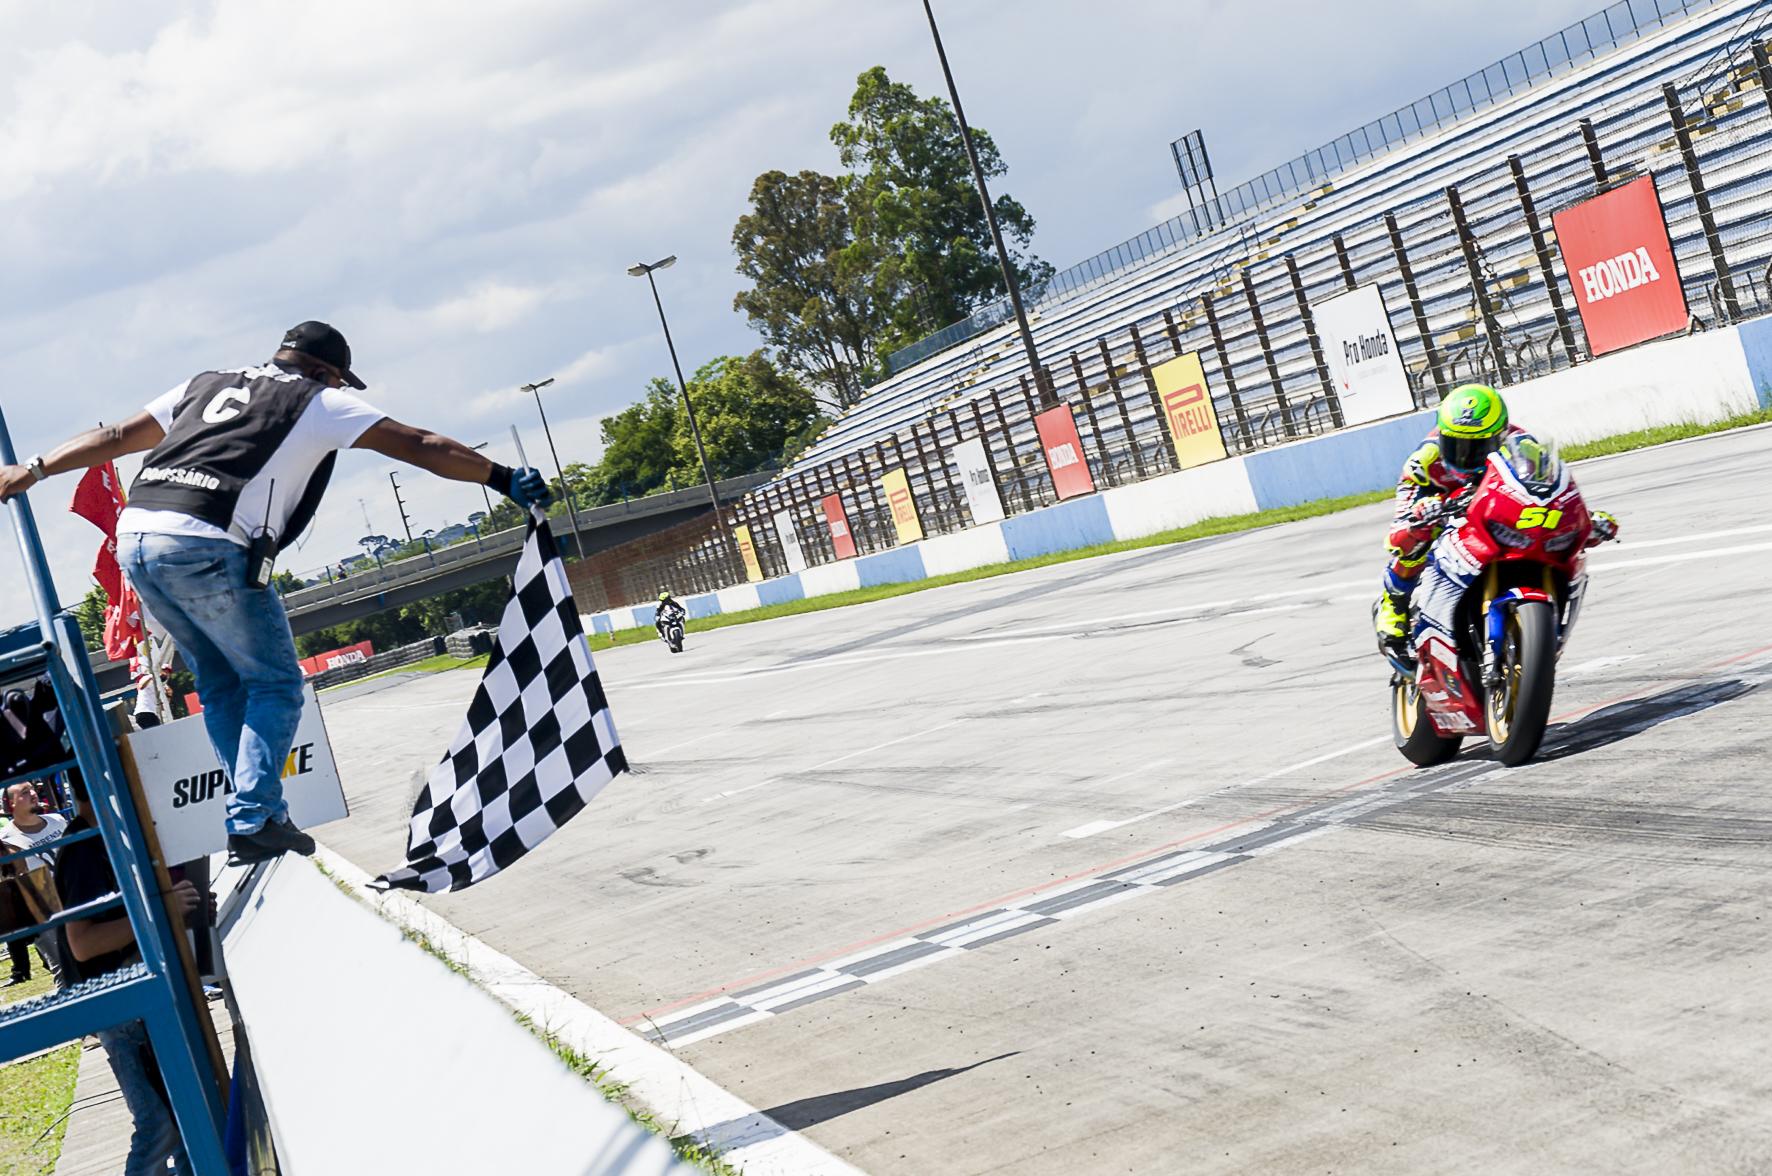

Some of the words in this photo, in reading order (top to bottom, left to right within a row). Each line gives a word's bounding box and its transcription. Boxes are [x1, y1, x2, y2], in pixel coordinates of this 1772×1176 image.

[1579, 246, 1660, 303] HONDA
[1343, 340, 1360, 367] Pro
[1359, 329, 1388, 361] Honda
[202, 386, 250, 424] C
[1164, 383, 1212, 440] PIRELLI
[140, 467, 220, 490] COMSSÁRIO
[1516, 507, 1563, 530] 51
[326, 650, 367, 670] HONDA
